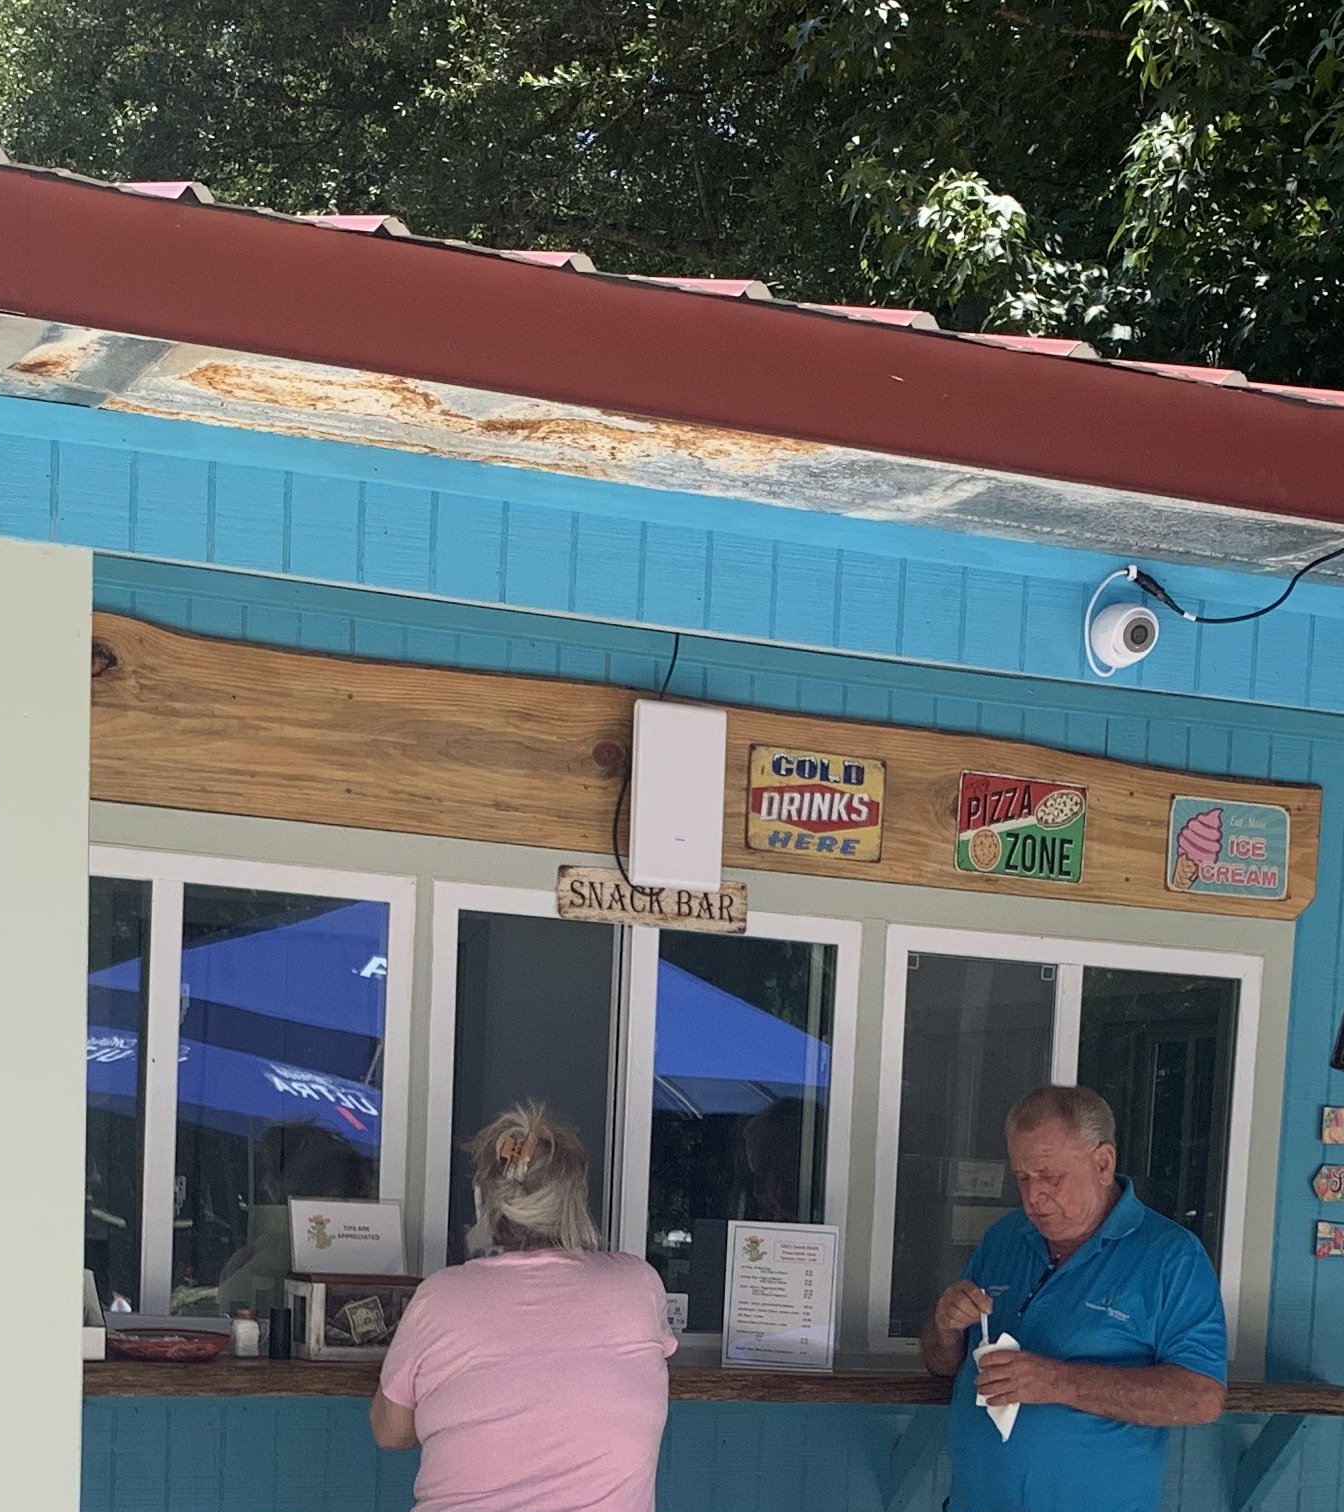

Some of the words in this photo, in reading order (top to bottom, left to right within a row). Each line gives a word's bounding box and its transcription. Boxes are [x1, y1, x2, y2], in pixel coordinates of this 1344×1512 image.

[771, 753, 865, 786] COLD
[760, 791, 870, 823] DRINKS
[968, 783, 1032, 830] PIZZA
[768, 830, 861, 856] HERE
[1005, 832, 1074, 878] ZONE
[1228, 835, 1267, 860] ICE
[1200, 863, 1279, 888] CREAM
[569, 880, 666, 915] SNACK
[676, 889, 735, 923] BAR
